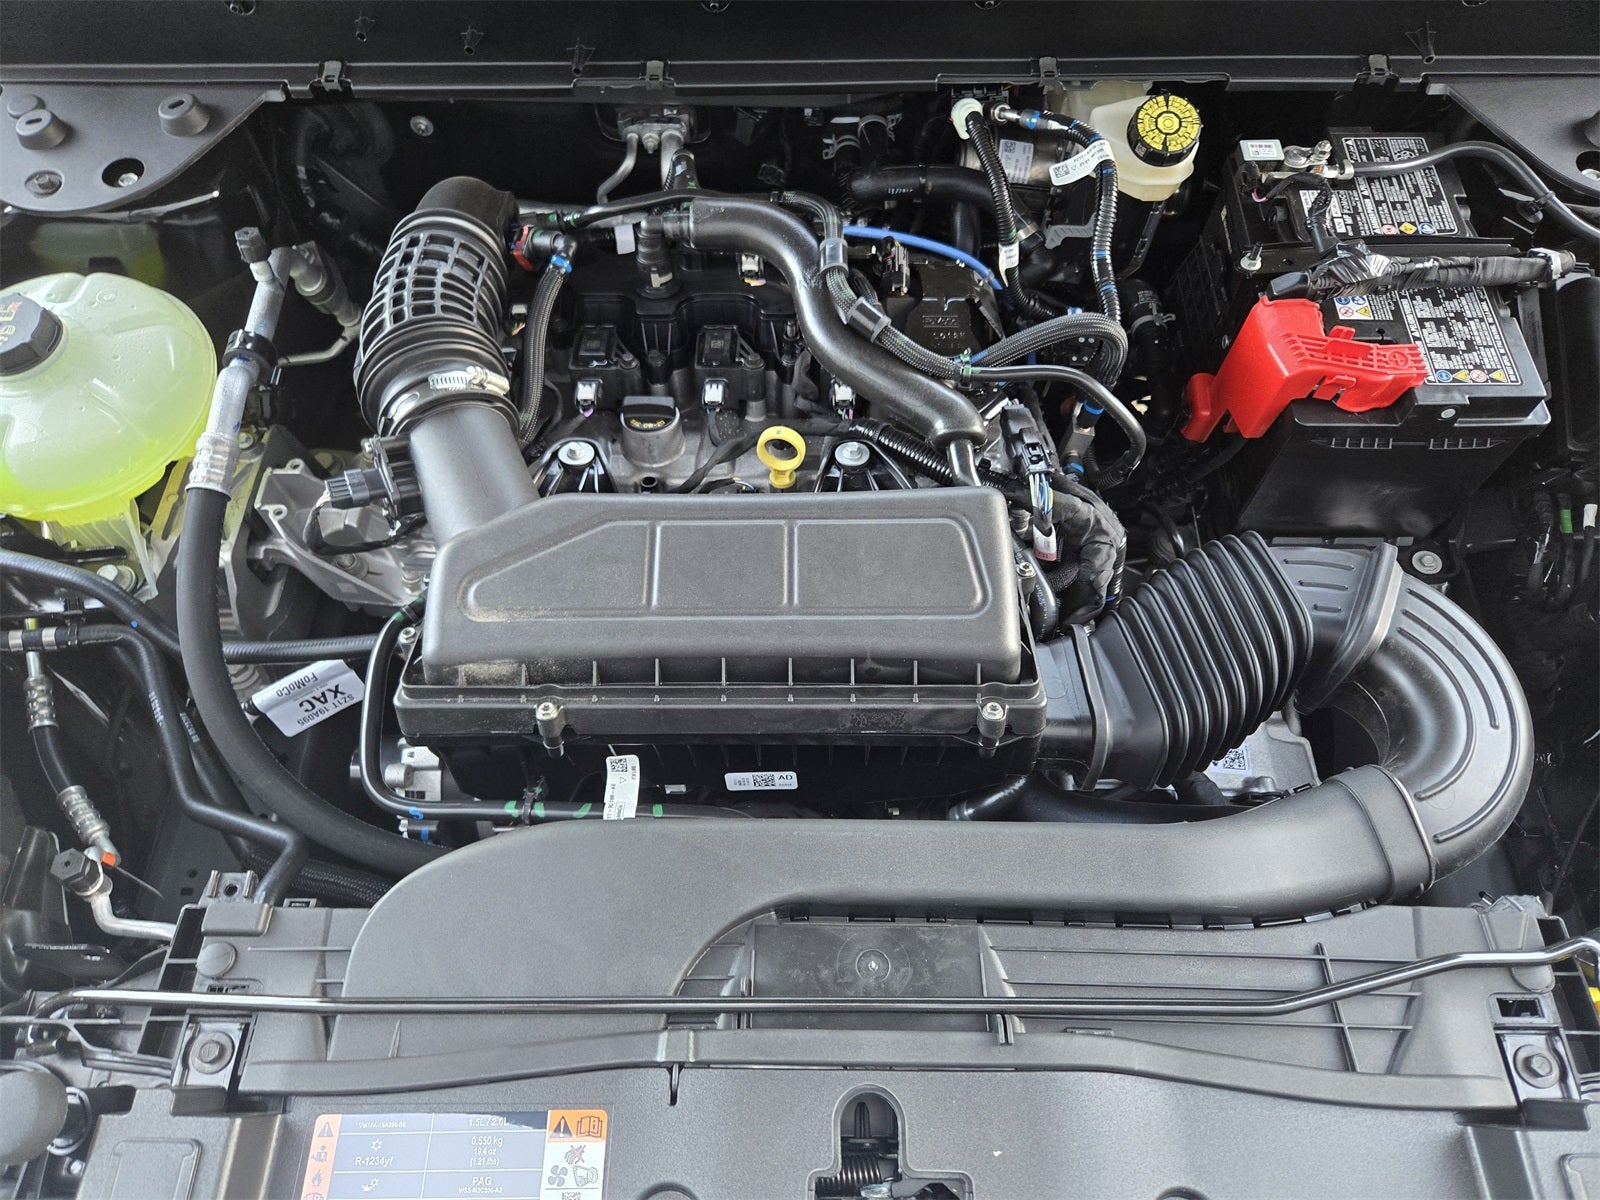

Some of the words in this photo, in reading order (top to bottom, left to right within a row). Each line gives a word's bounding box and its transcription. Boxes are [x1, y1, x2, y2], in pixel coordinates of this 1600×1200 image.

[1338, 191, 1351, 213] FoMoCo
[276, 672, 318, 697] FoMoCo
[299, 684, 346, 713] XAC
[297, 706, 329, 726] 19A095
[469, 1118, 485, 1127] 1.5L
[490, 1117, 508, 1126] 2.0L
[471, 1136, 491, 1145] 0.550
[493, 1135, 503, 1147] kg
[474, 1147, 487, 1155] 19.4
[355, 1156, 394, 1168] R-1234yf
[470, 1157, 486, 1167] (1.21
[487, 1157, 500, 1166] lbs)
[472, 1176, 492, 1186] PAG
